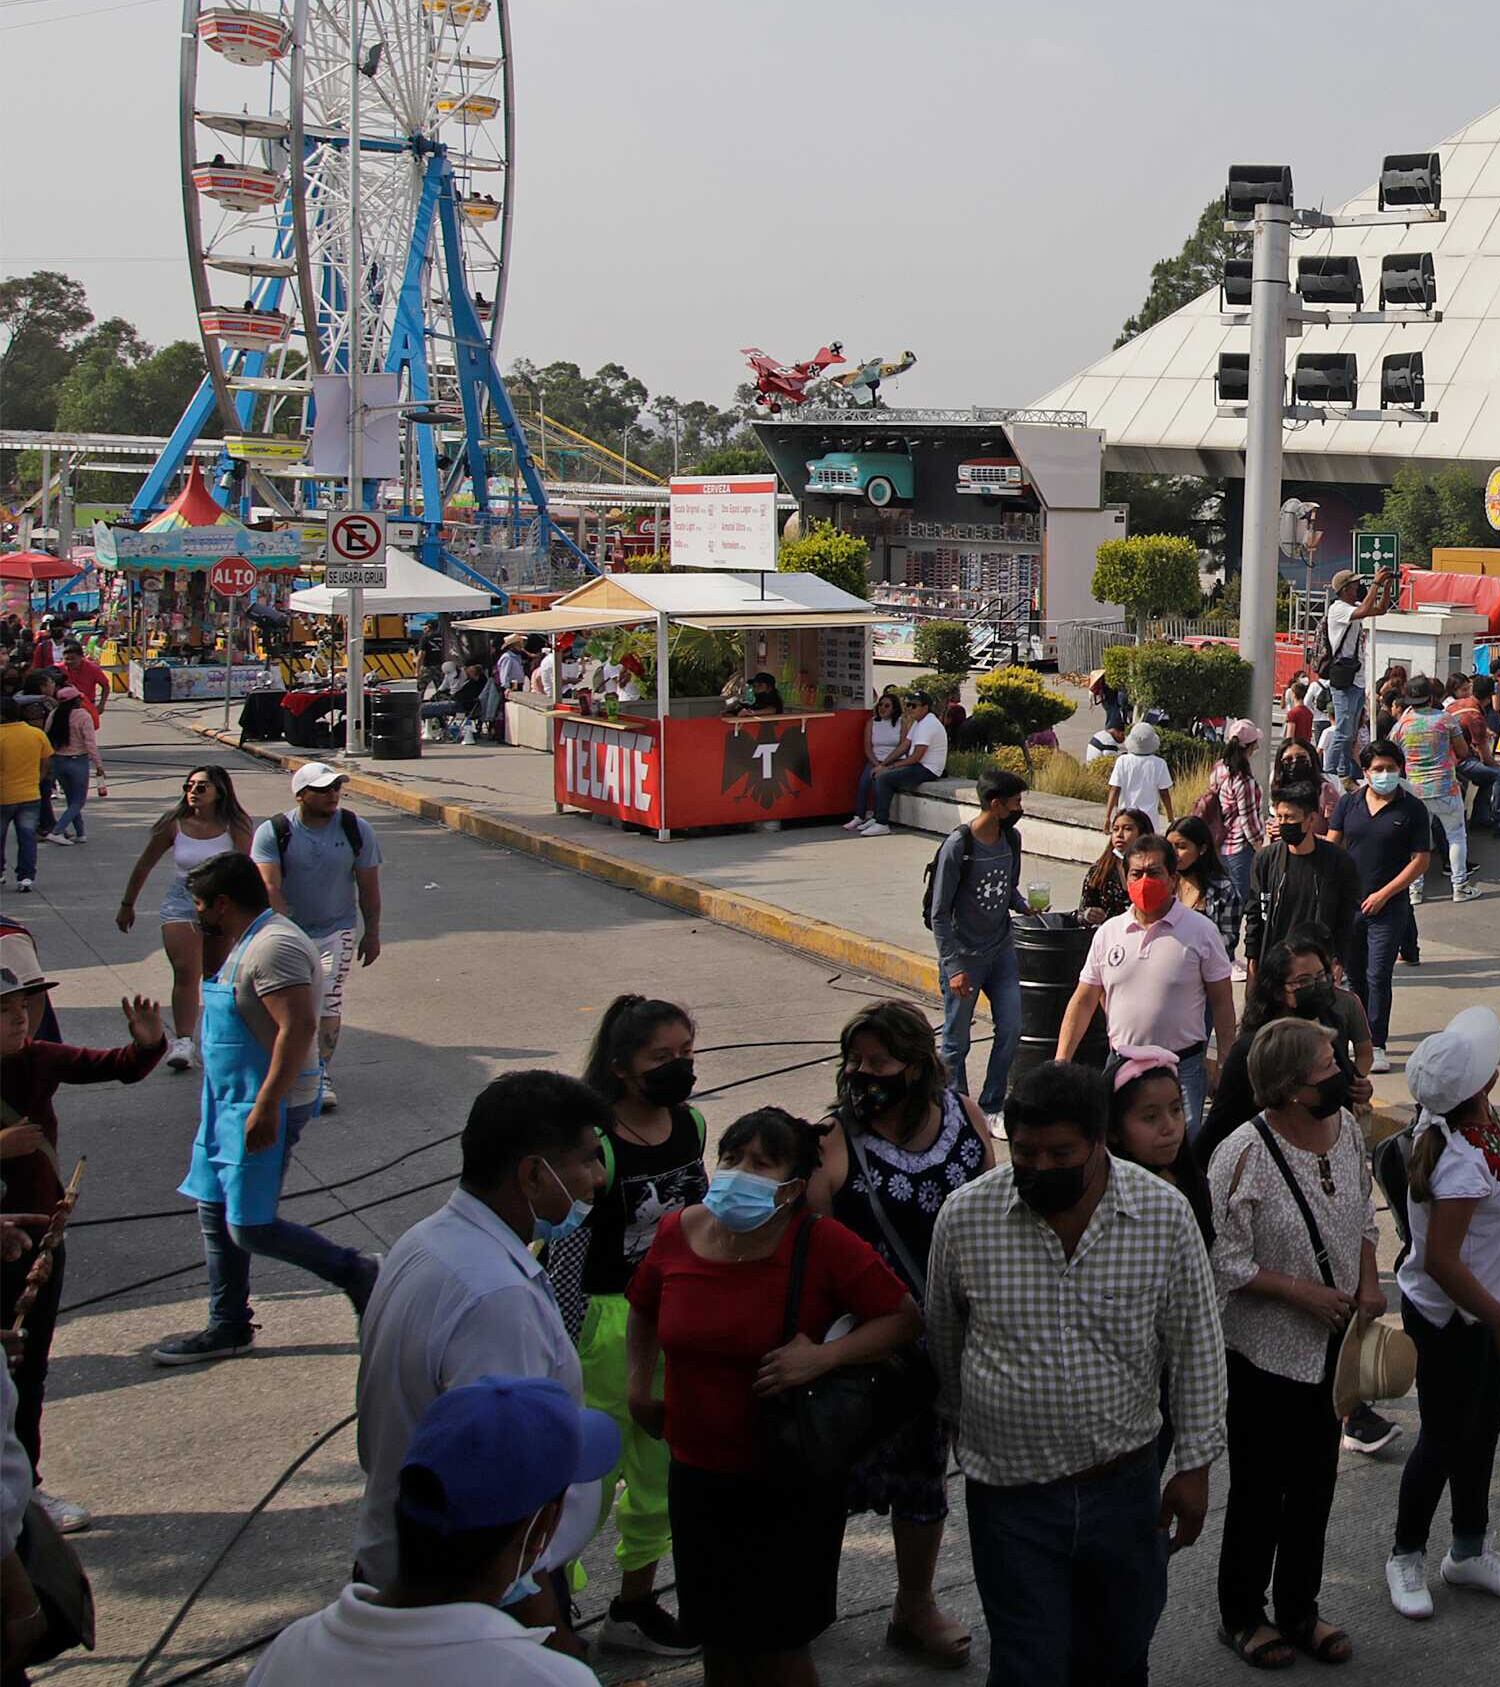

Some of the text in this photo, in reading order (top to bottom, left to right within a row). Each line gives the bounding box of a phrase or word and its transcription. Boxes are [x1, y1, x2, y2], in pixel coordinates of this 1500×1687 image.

[703, 484, 731, 493] CERVEZA
[213, 568, 254, 586] ALTO
[328, 571, 338, 584] SE
[364, 571, 384, 584] GRUA
[752, 743, 780, 779] T
